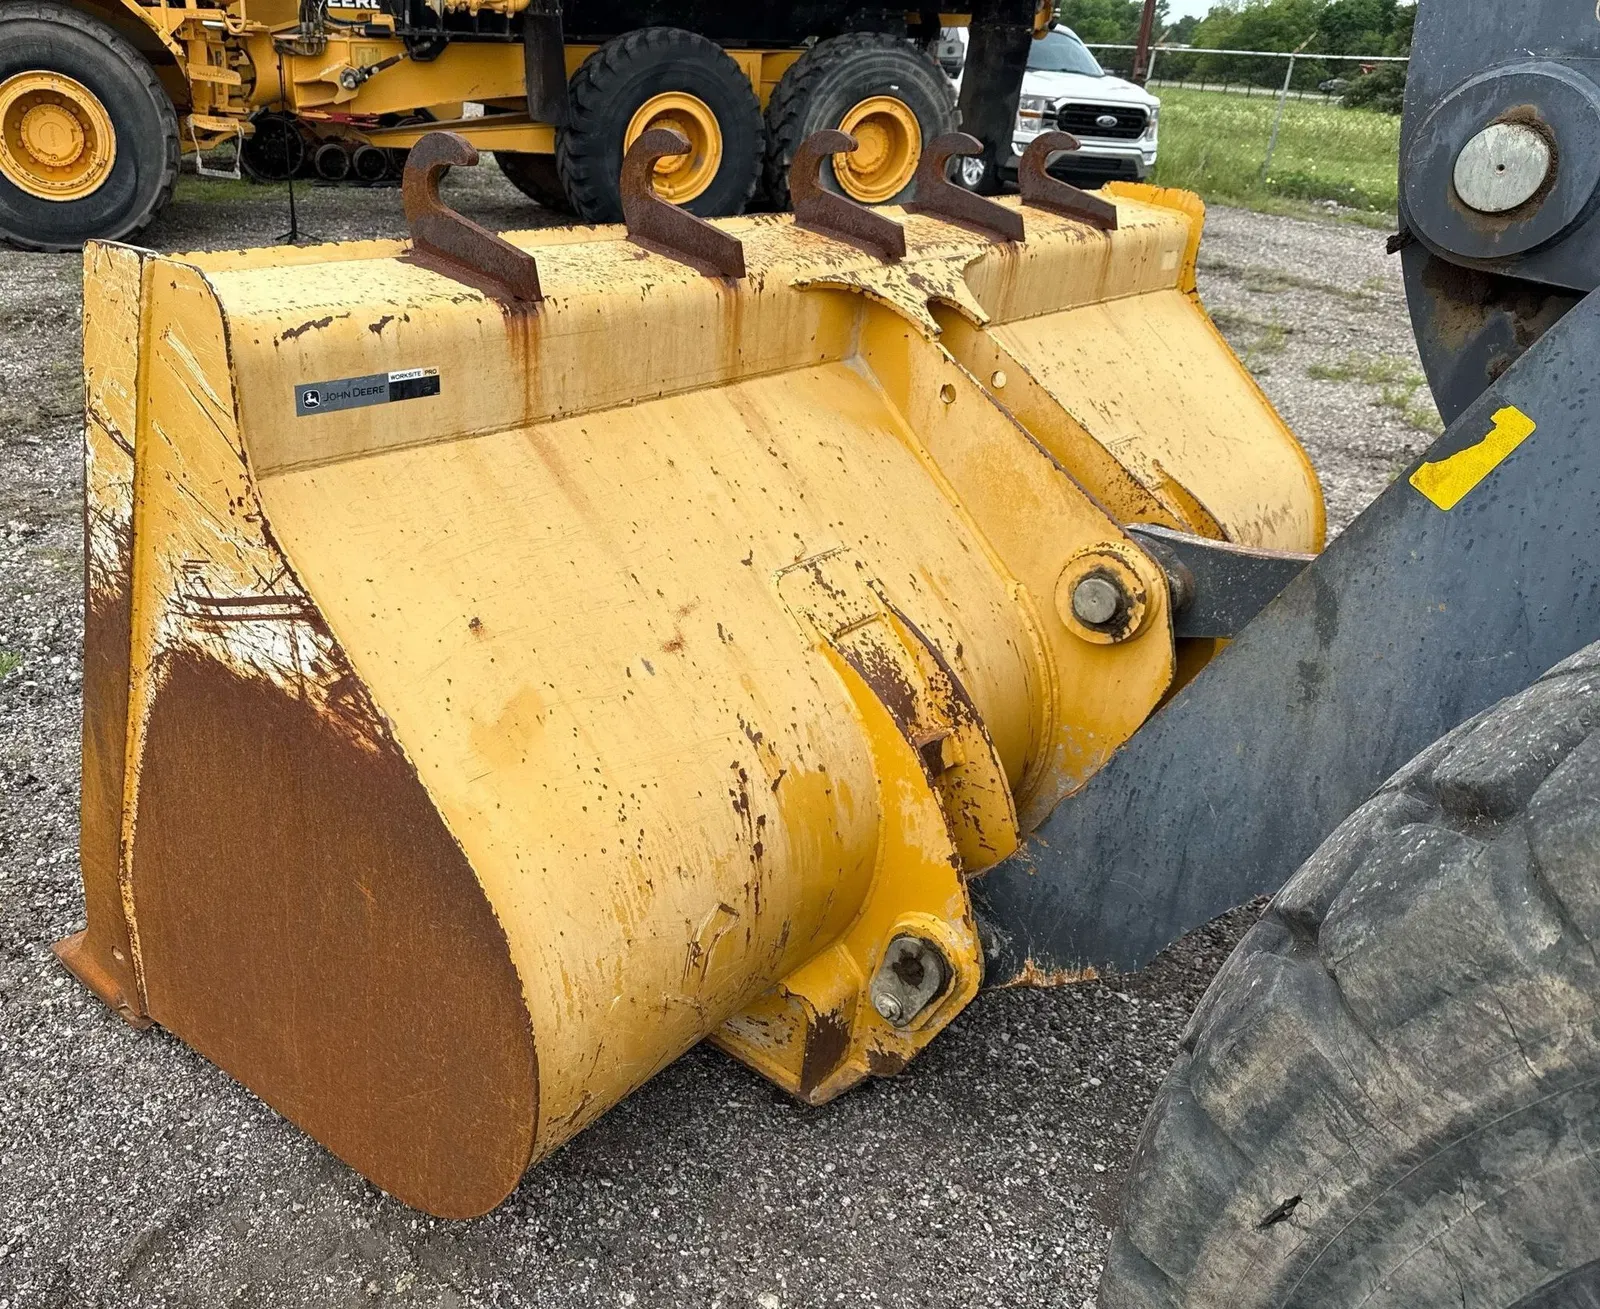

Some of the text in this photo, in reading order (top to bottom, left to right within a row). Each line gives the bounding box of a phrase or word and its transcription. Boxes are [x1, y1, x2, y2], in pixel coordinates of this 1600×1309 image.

[390, 368, 437, 381] WORKSITE PRO
[323, 385, 385, 402] JOHN DEERE
